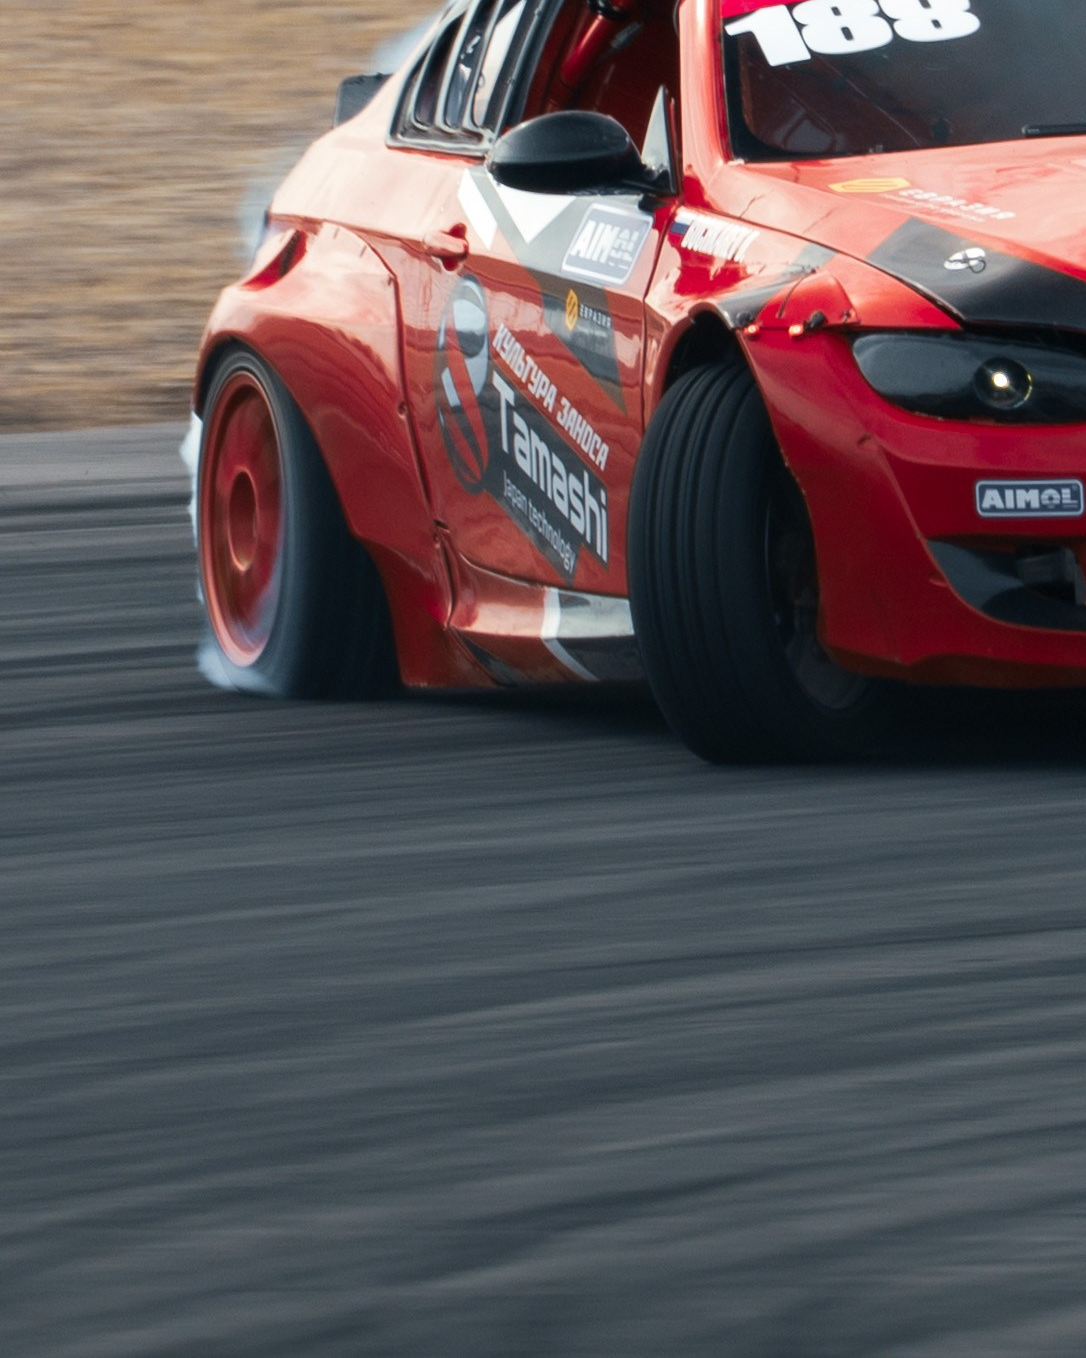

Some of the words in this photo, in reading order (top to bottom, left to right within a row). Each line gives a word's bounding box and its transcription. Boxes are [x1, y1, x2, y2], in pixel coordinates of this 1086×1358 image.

[492, 322, 558, 413] КУЛЬТУРА
[556, 396, 610, 472] ЗАНОСА
[492, 369, 608, 564] Tamashi
[981, 487, 1079, 509] AIMOL
